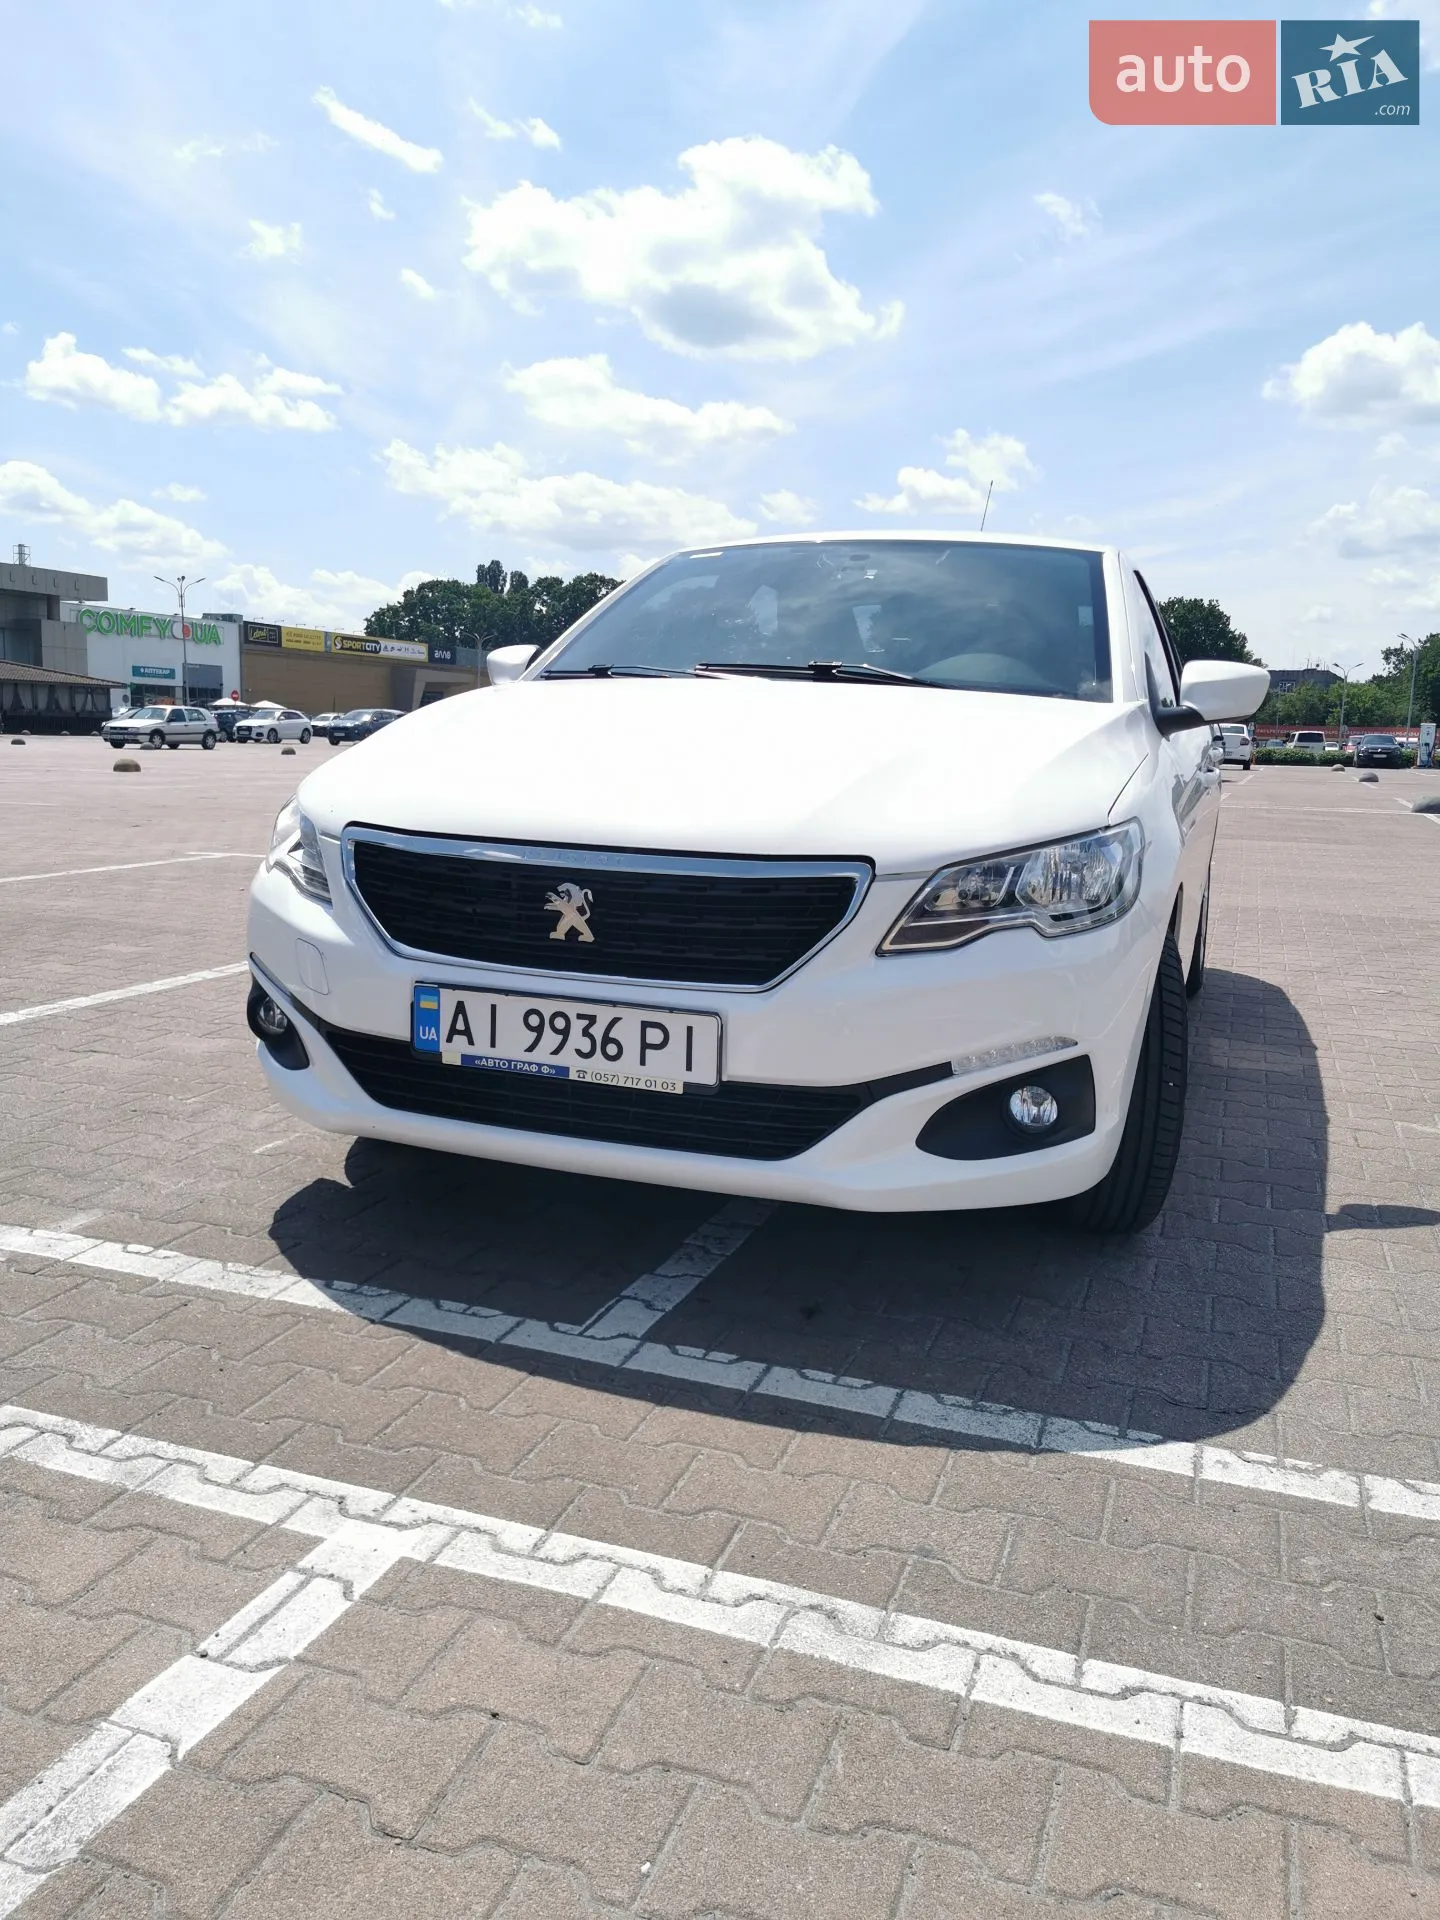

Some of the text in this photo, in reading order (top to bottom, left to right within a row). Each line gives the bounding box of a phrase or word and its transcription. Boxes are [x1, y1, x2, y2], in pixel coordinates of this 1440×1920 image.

[419, 1026, 438, 1041] UA
[446, 1000, 693, 1072] AI 9936 PI
[590, 1071, 676, 1092] (057) 717 01 03
